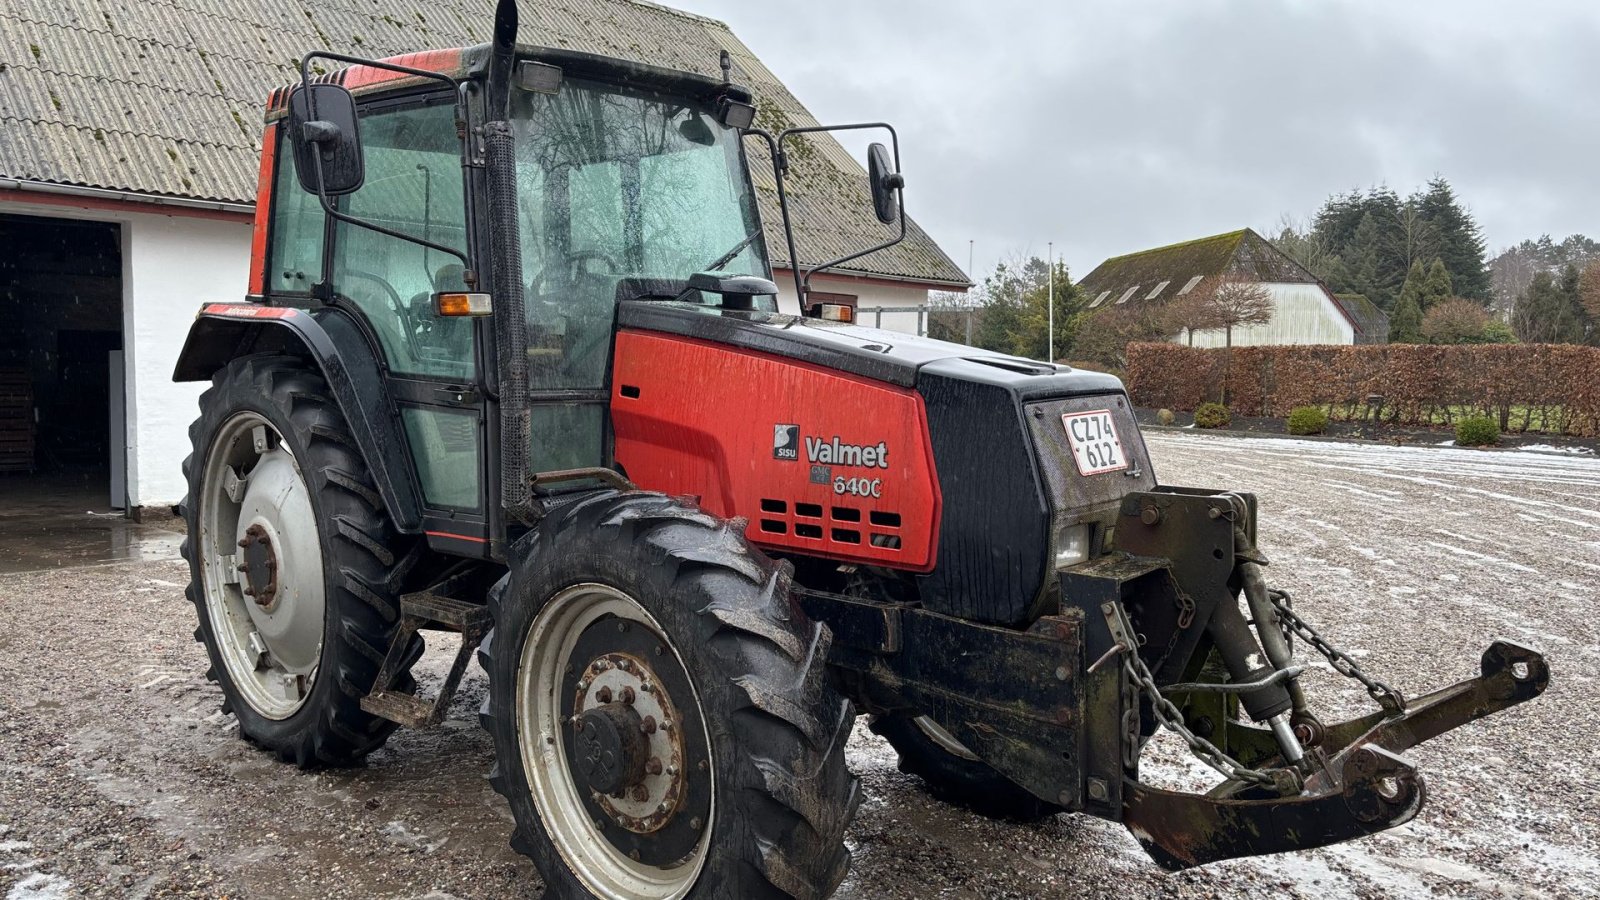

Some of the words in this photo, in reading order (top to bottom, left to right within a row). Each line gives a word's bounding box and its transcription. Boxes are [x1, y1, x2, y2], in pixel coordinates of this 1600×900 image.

[1070, 415, 1114, 442] CZ74
[777, 447, 796, 458] SISU
[805, 436, 888, 468] Valmet
[1086, 441, 1117, 468] 612
